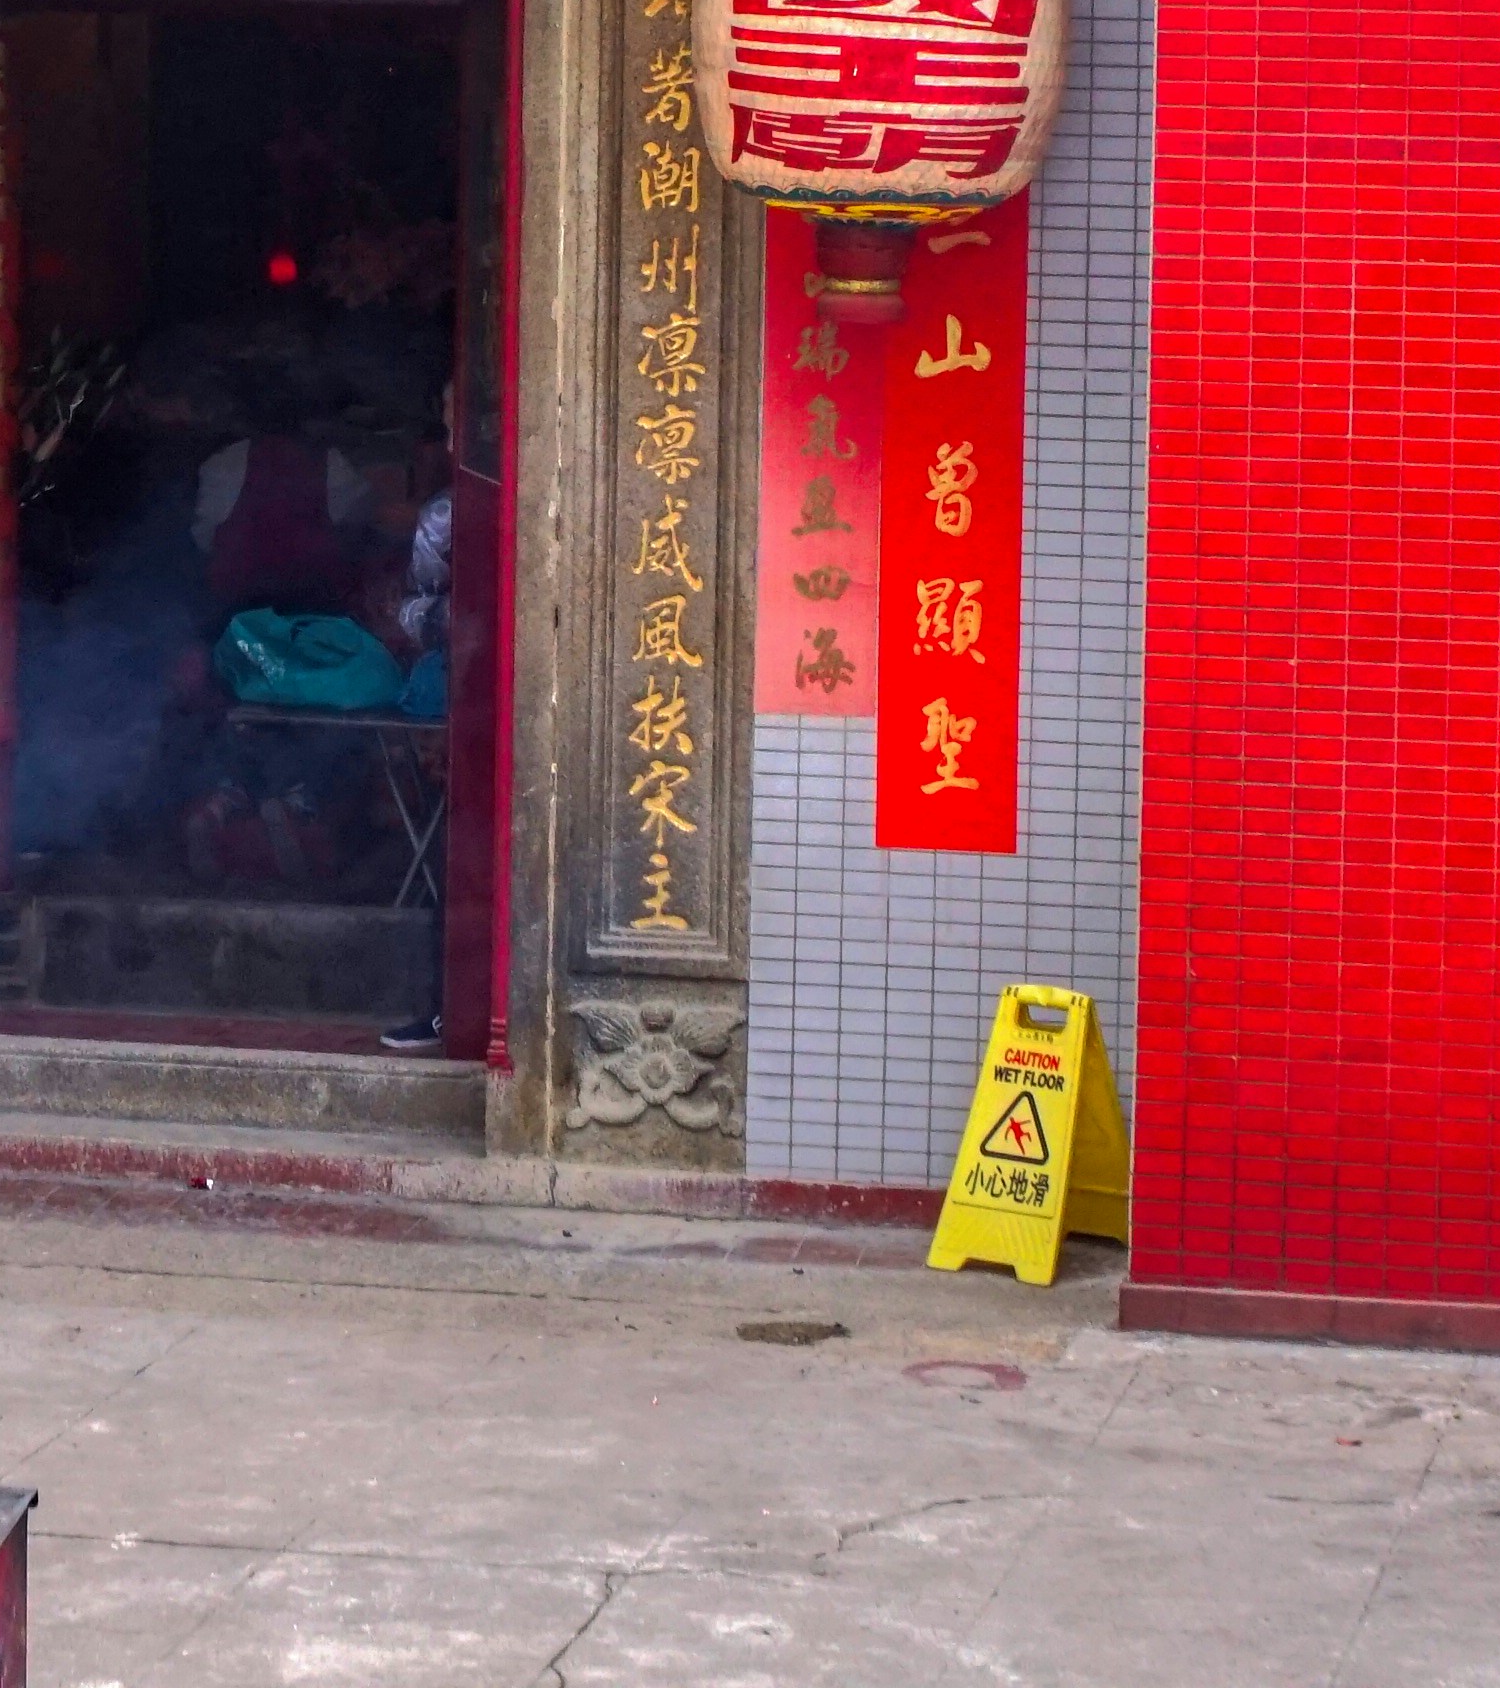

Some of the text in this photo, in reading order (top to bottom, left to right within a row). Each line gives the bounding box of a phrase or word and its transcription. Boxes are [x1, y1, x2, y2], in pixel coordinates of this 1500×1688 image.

[1004, 1048, 1060, 1070] CAUTION
[994, 1066, 1064, 1091] WET FLOOR
[966, 1163, 1049, 1207] 小心地滑
